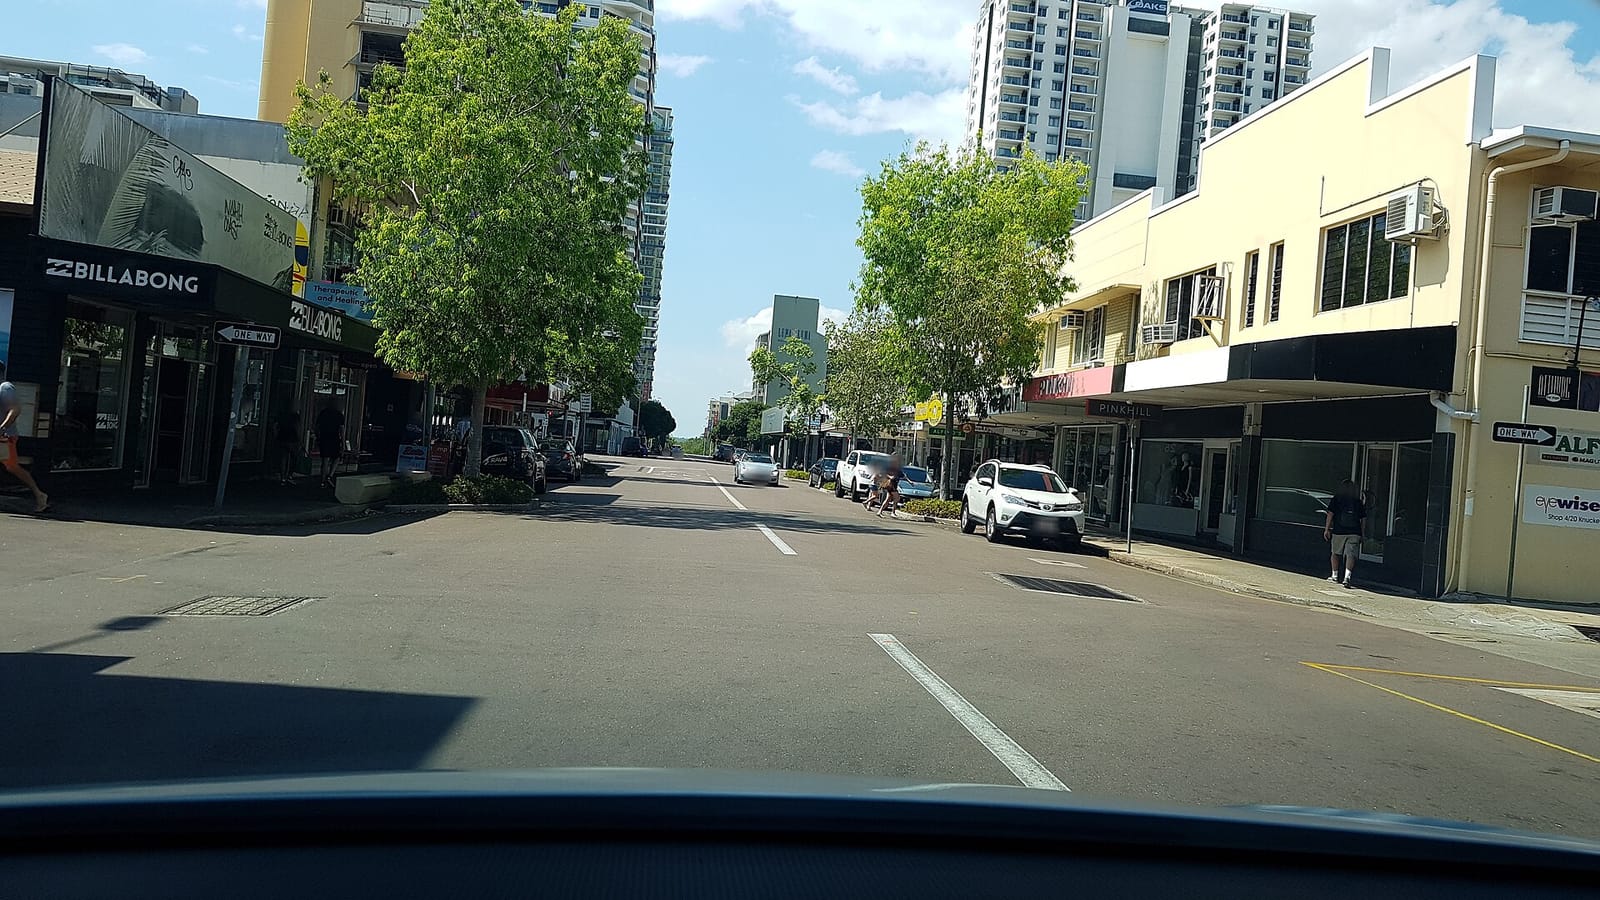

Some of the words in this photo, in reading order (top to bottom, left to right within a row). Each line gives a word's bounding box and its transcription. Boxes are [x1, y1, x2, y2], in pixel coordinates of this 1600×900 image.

[1131, 0, 1167, 10] OAKS
[74, 261, 199, 294] BILLABONG
[313, 285, 358, 296] Therapeutic
[317, 295, 333, 303] and
[335, 296, 365, 307] Healing
[234, 329, 251, 340] ONE
[256, 331, 273, 342] WAY
[1099, 403, 1151, 417] PINKHILL
[1500, 428, 1517, 437] ONE
[1521, 429, 1537, 439] WAY
[1535, 495, 1600, 514] eyewise
[1548, 513, 1563, 521] Shop
